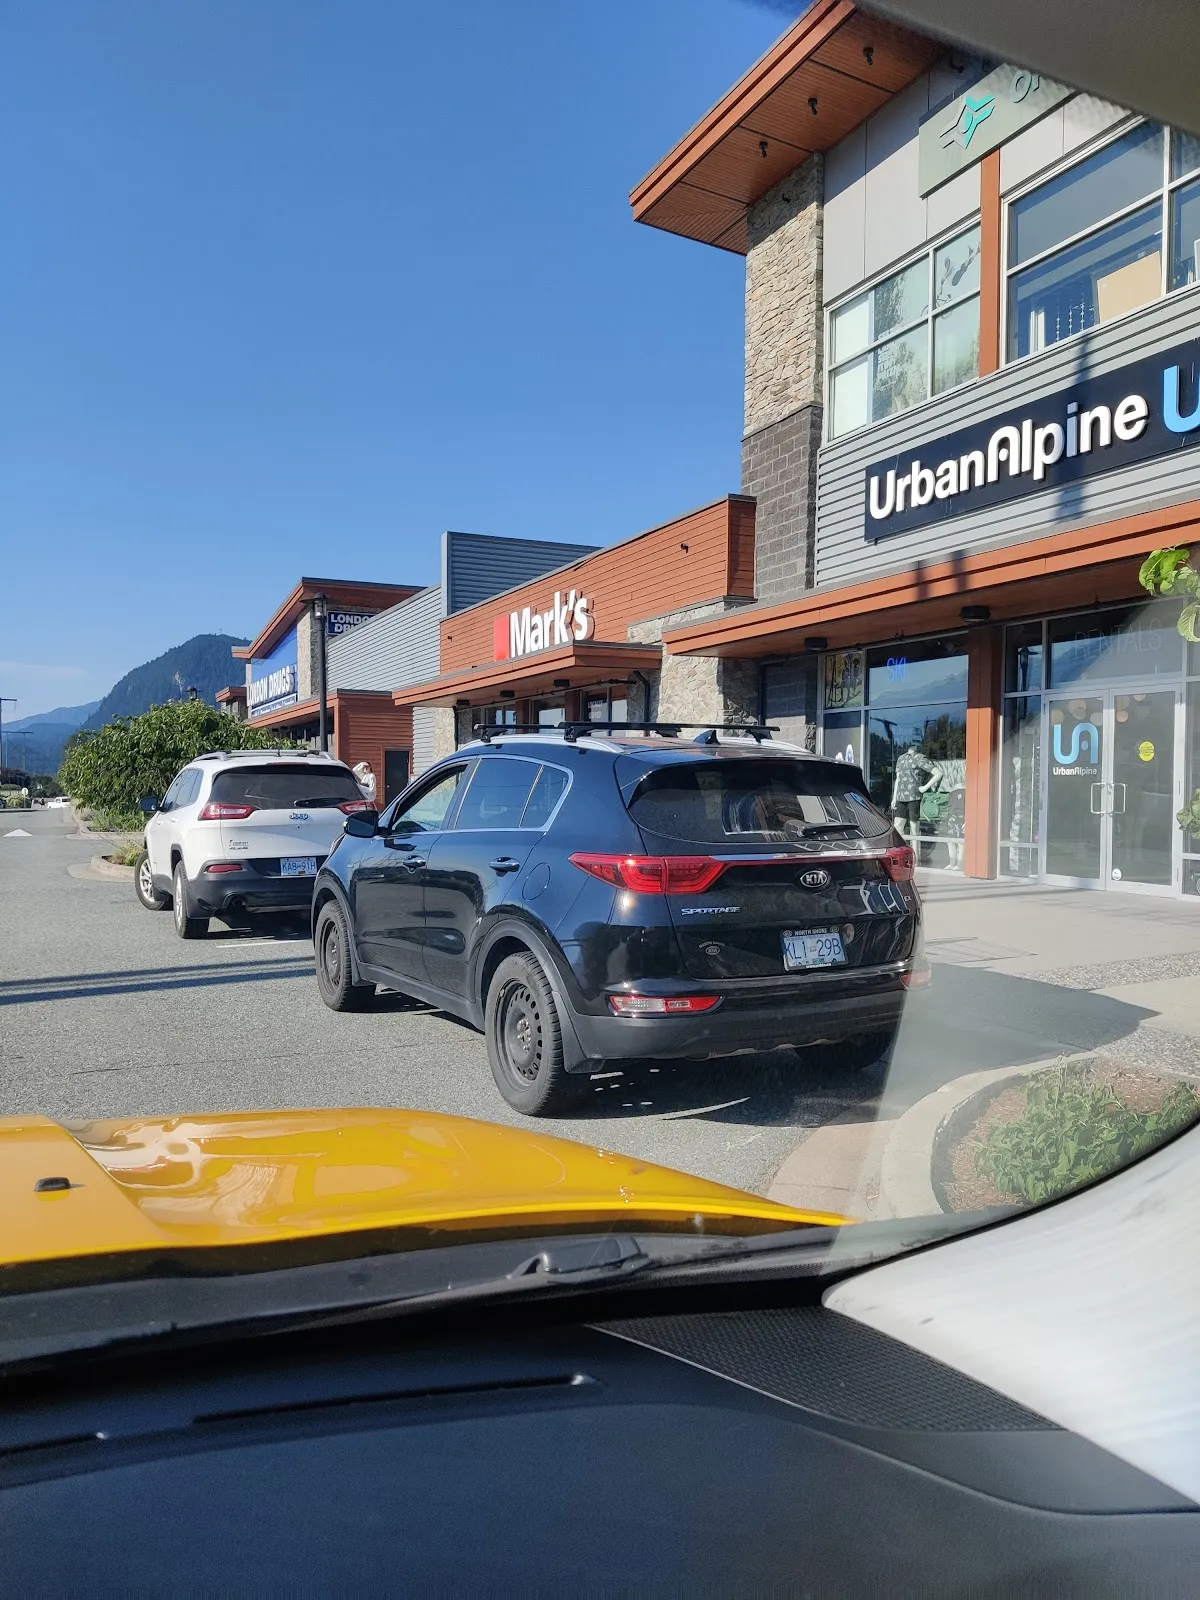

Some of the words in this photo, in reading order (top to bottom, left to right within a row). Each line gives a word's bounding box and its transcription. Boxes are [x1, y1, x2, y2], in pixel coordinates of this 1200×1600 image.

[868, 394, 1149, 520] UrbanAlpine
[330, 613, 371, 625] LONDO
[509, 588, 589, 659] Mark's
[886, 657, 908, 682] SKI
[268, 665, 291, 699] DRUGS
[1052, 766, 1098, 777] UrbanAlpine
[681, 906, 741, 916] SPORTAGE
[816, 938, 841, 957] 29B
